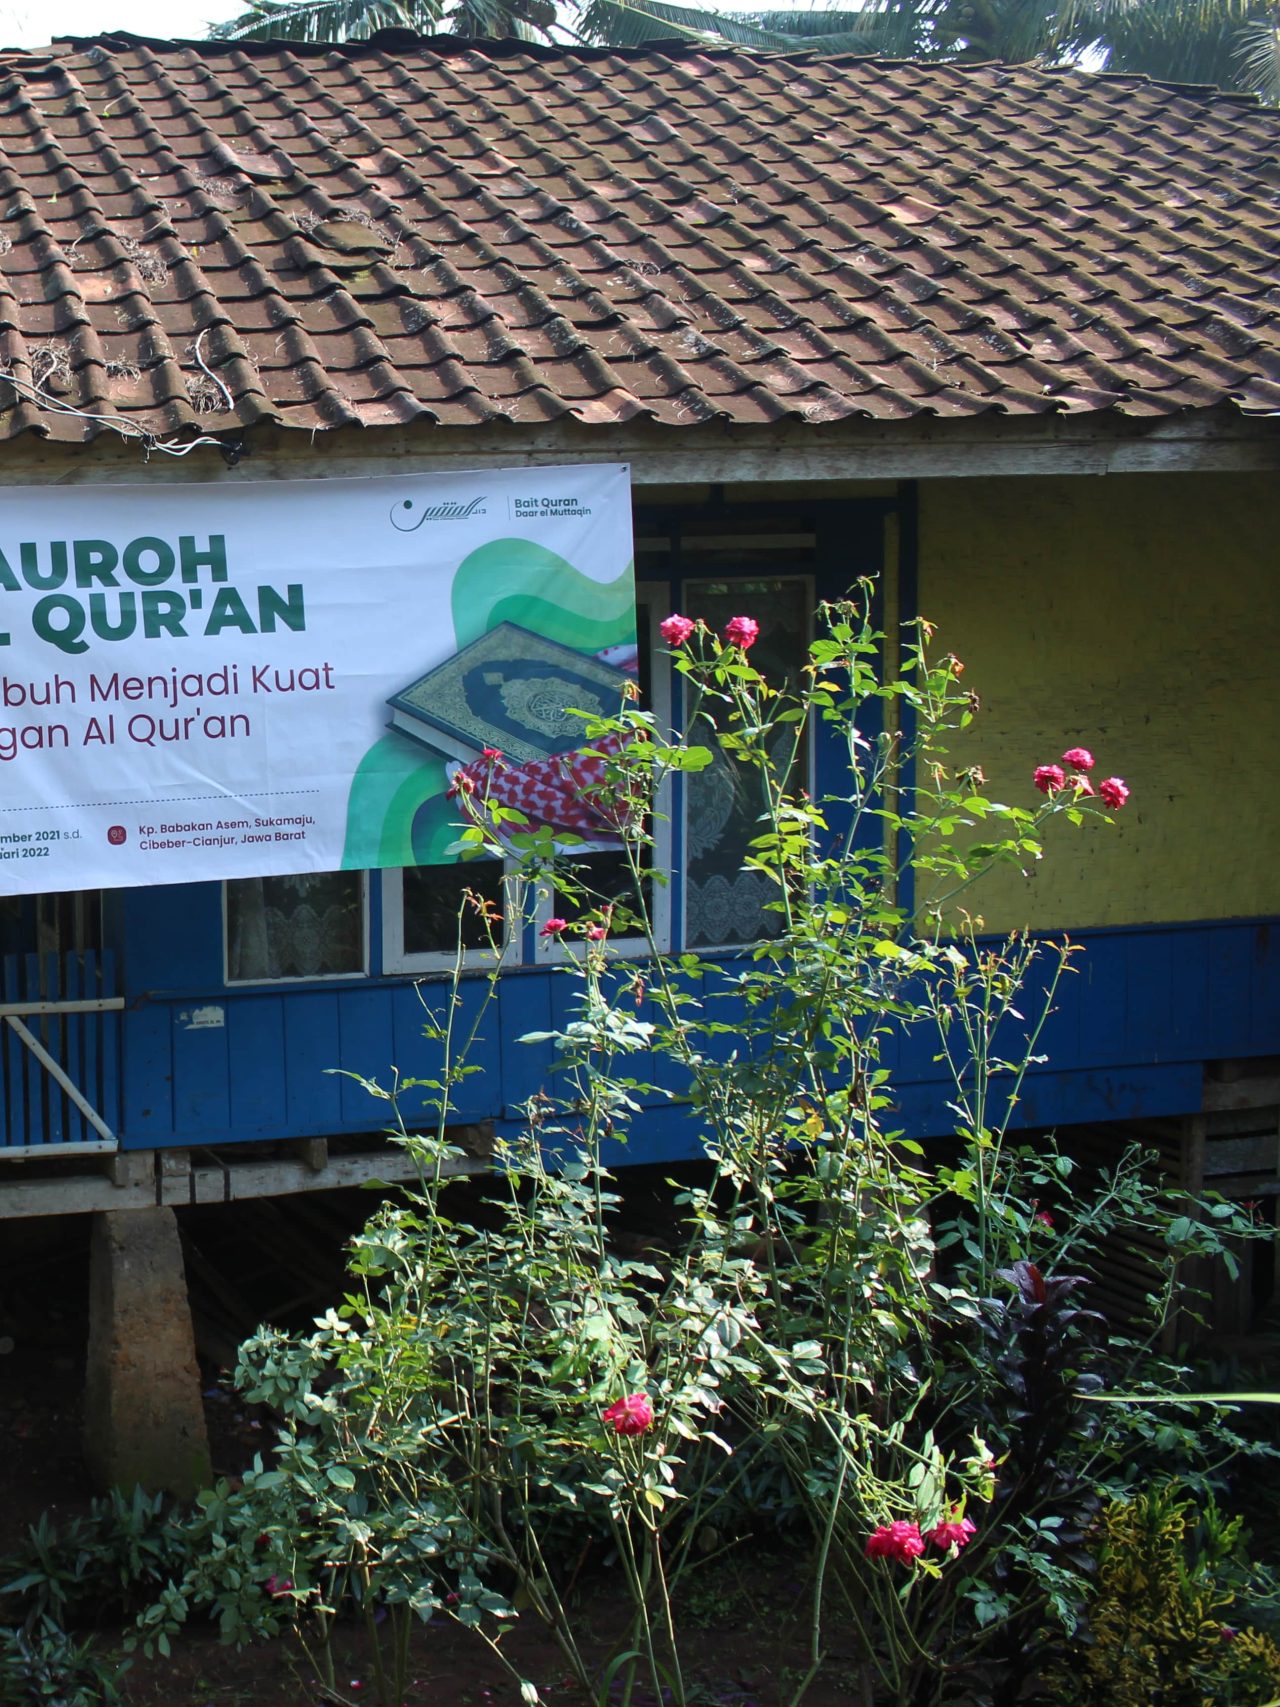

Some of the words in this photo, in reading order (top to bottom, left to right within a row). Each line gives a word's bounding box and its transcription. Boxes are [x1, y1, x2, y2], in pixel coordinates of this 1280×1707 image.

[515, 498, 538, 508] Bait
[541, 498, 578, 508] Quran
[515, 509, 538, 518] Daar
[540, 509, 548, 517] el
[550, 507, 591, 519] Muttaqin
[32, 584, 306, 654] QUR'AN
[90, 663, 239, 707] Menjadi
[252, 662, 335, 693] Kuat
[82, 715, 115, 746] Al
[128, 708, 251, 746] Qur'an
[35, 830, 61, 842] 2021
[63, 829, 82, 841] s.d.
[139, 825, 158, 837] Kp.
[160, 822, 213, 834] Babakan
[216, 820, 252, 831] Asem,
[254, 814, 316, 828] Sukamaju,
[140, 835, 238, 850] Cibeber-Cianjur,
[241, 833, 272, 844] Jawa
[274, 830, 306, 841] Barat
[22, 847, 50, 859] 2022
